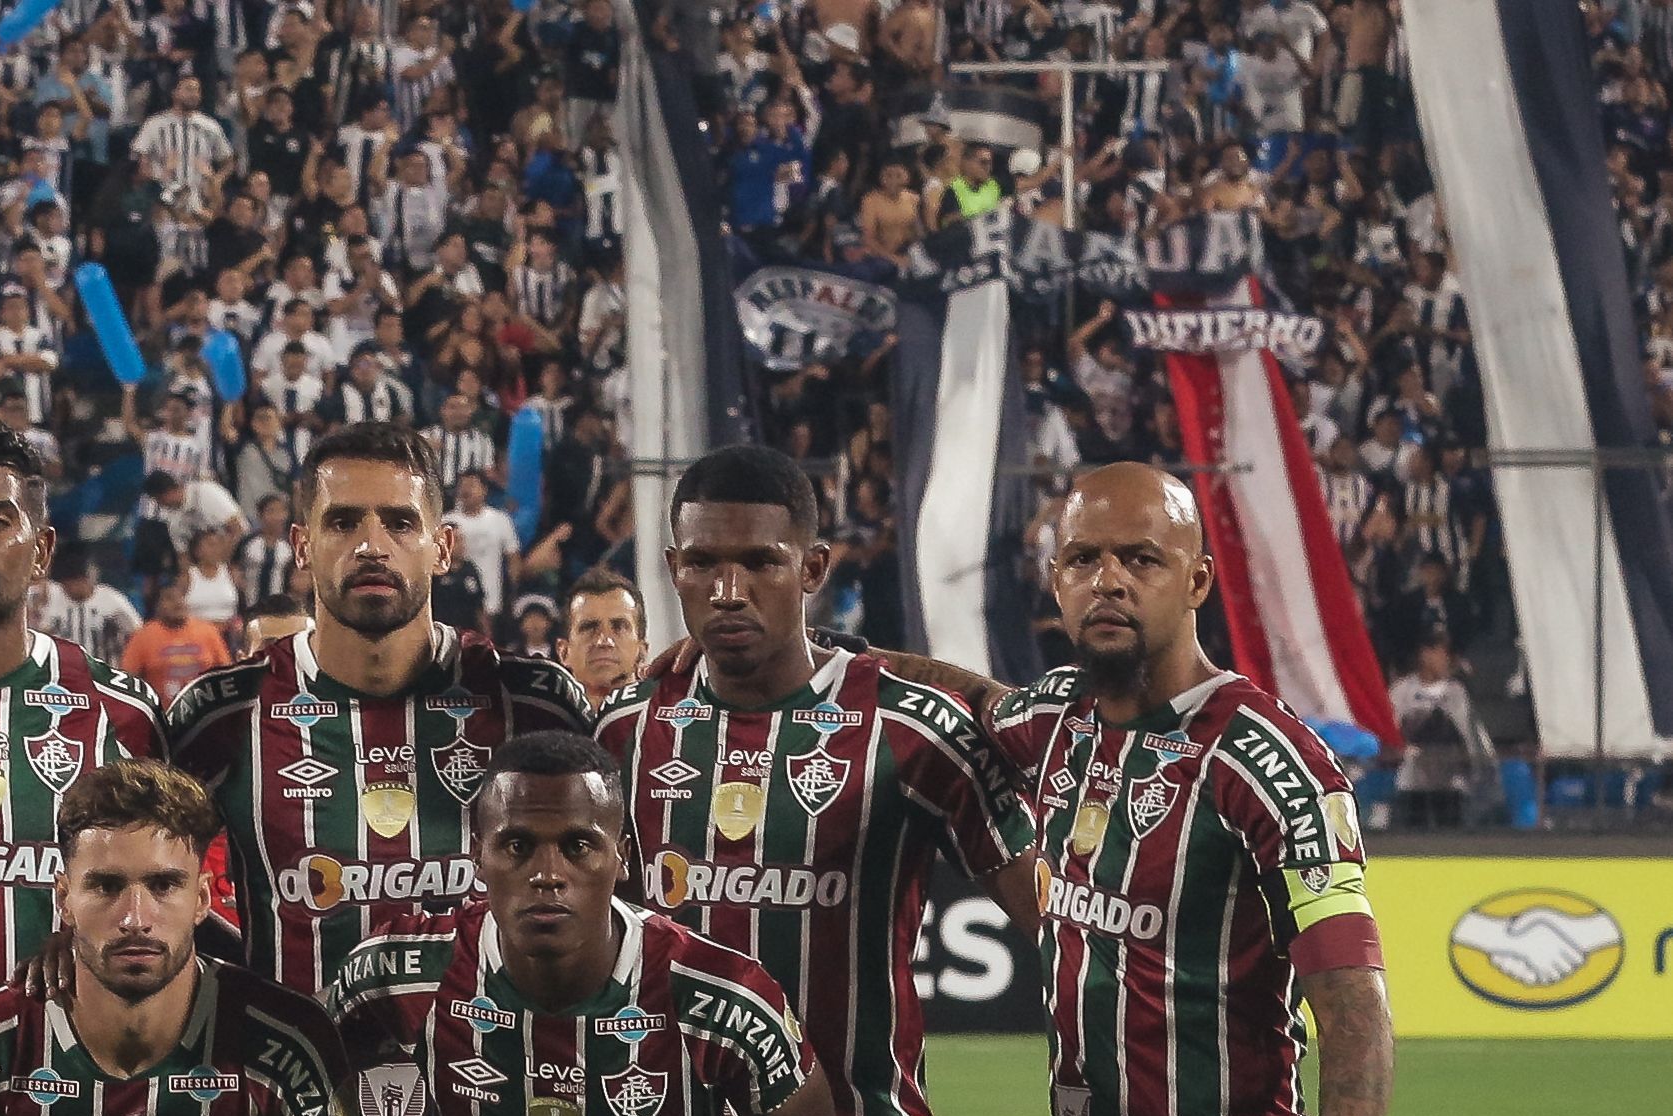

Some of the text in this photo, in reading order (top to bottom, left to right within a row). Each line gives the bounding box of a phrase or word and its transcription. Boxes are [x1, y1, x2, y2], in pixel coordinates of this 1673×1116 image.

[29, 693, 86, 707] FRESCATTO
[275, 703, 337, 717] FRESCATTO
[797, 711, 859, 725] FRESCATTO
[355, 744, 415, 763] Leve
[717, 744, 773, 766] Leve
[898, 691, 1014, 813] ZINZANE
[283, 786, 333, 798] umbro
[650, 788, 693, 800] umbro
[454, 1003, 512, 1026] FRESCATTO
[598, 1017, 663, 1032] FRESCATTO
[689, 990, 790, 1086] ZINZANE
[525, 1056, 586, 1082] Leve
[15, 1079, 76, 1094] FRESCATTO
[173, 1076, 238, 1090] FRESCATTO
[451, 1083, 500, 1102] umbro
